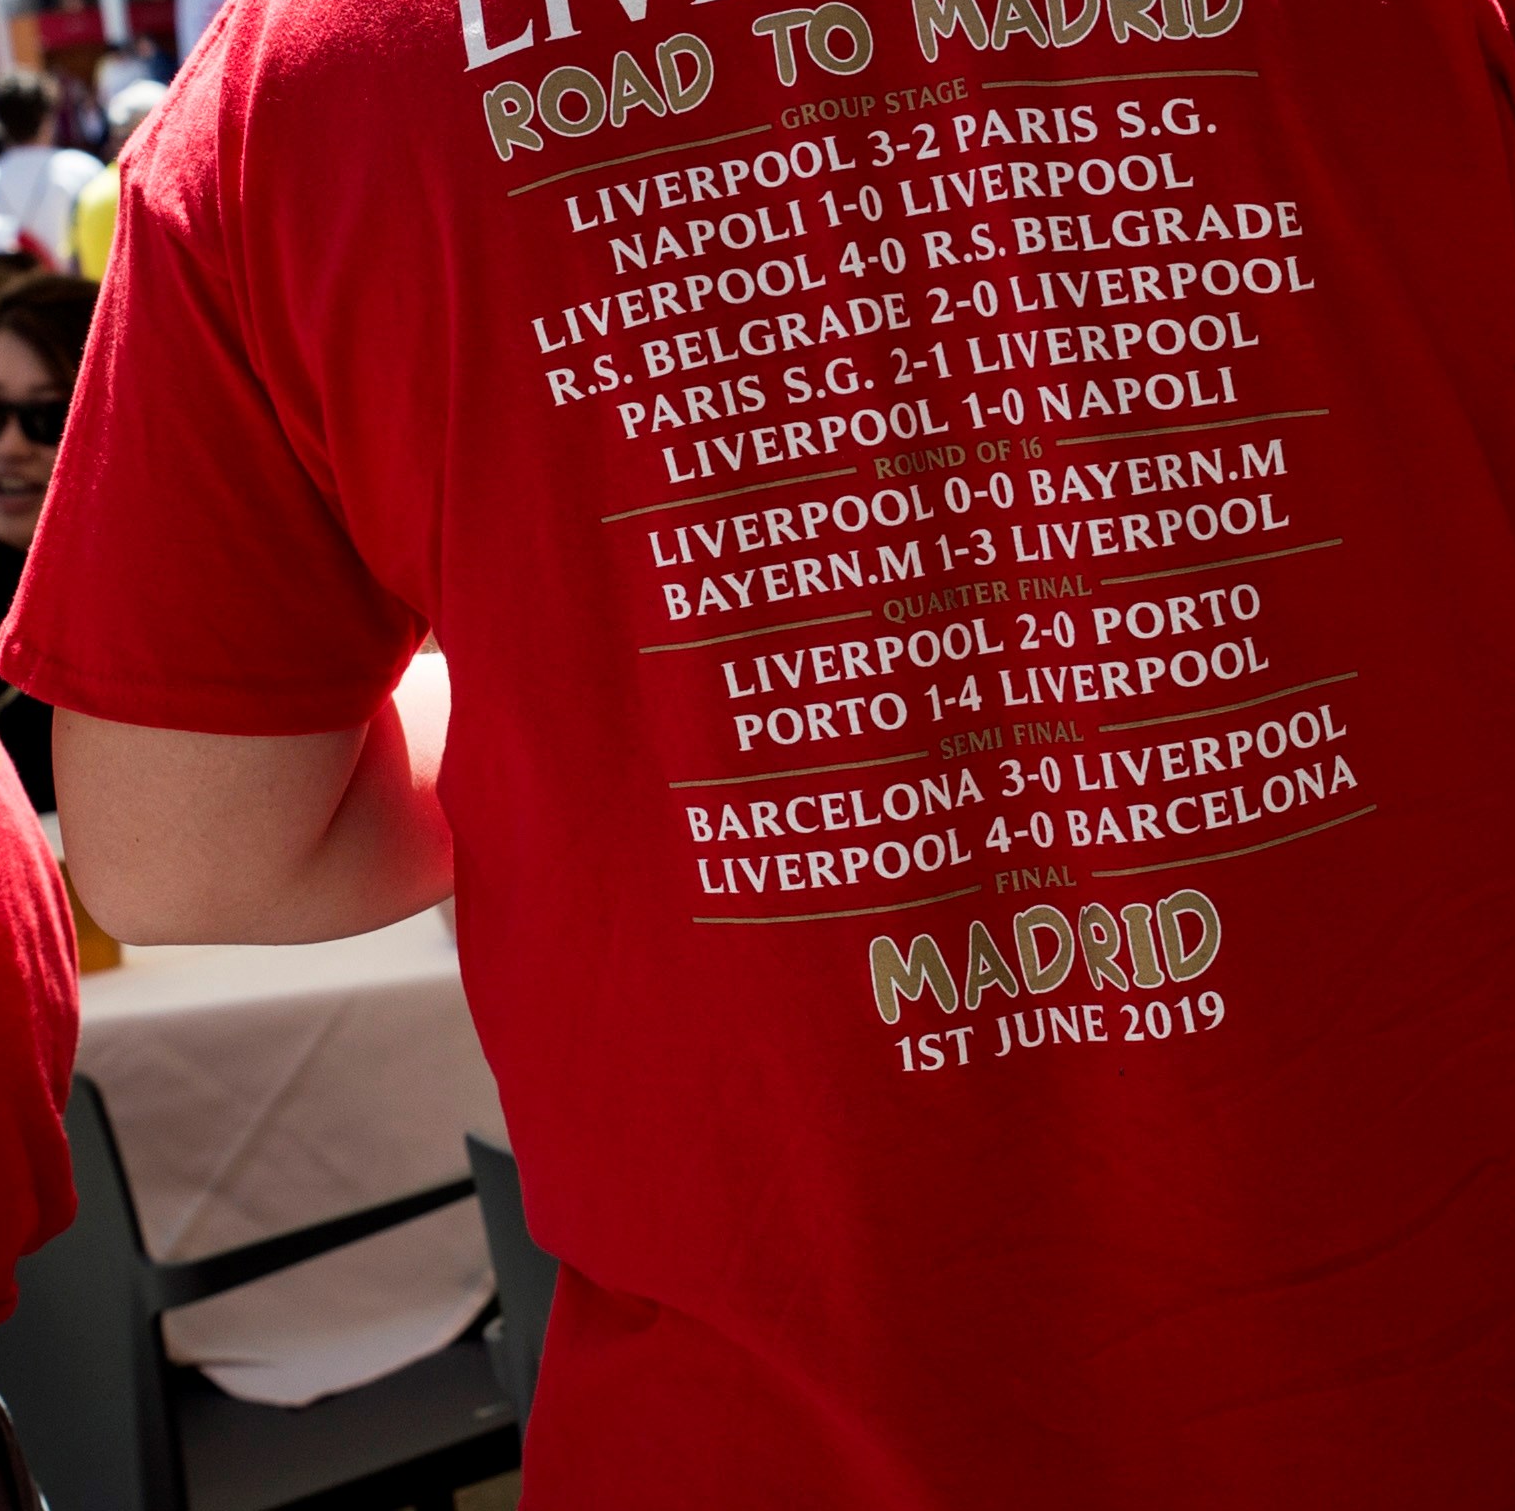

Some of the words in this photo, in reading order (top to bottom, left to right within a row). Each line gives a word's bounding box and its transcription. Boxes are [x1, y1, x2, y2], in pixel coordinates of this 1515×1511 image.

[482, 32, 715, 163] ROAD
[751, 1, 874, 88] TO
[780, 96, 880, 130] GROUP
[884, 77, 969, 114] STAGE
[565, 135, 856, 233] LIVERPOOL
[867, 123, 940, 167] 3-2
[952, 105, 1098, 153] PARIS
[1116, 97, 1217, 139] S.G.
[608, 199, 808, 275] NAPOLI
[818, 185, 883, 228] 1-0
[898, 152, 1194, 217] LIVERPOOL
[531, 253, 827, 354] LIVERPOOL
[838, 237, 906, 278] 4-0
[922, 223, 1006, 269] R.S.
[1011, 201, 1303, 255] BELGRADE
[545, 354, 633, 407] R.S.
[640, 292, 911, 379] BELGRADE
[926, 280, 999, 324] 2-0
[1009, 255, 1315, 313] LIVERPOOL
[616, 374, 766, 440] PARIS
[783, 357, 874, 404] S.G.
[890, 341, 952, 385] 2-1
[966, 311, 1259, 374] LIVERPOOL
[661, 398, 949, 484] LIVERPOOL
[961, 388, 1025, 429] 1-0
[1037, 366, 1238, 423] NAPOLI
[647, 484, 934, 568] LIVERPOOL
[944, 472, 1015, 514] 0-0
[1028, 438, 1288, 506] BAYERN.M
[873, 445, 966, 480] ROUND
[976, 439, 1011, 464] OF
[661, 540, 926, 621] BAYERN.M
[935, 528, 997, 571] 1-3
[1010, 493, 1290, 563] LIVERPOOL
[883, 580, 1010, 624] QUARTER
[1018, 574, 1093, 601] FINAL
[721, 618, 1004, 699] LIVERPOOL
[1015, 610, 1075, 650] 2-0
[1091, 584, 1260, 645] PORTO
[733, 692, 908, 752] PORTO
[924, 674, 983, 722] 1-4
[998, 636, 1269, 706] LIVERPOOL
[685, 768, 985, 843] BARCELONA
[999, 756, 1061, 797] 3-0
[1073, 704, 1347, 791] LIVERPOOL
[941, 727, 1003, 760] SEMI
[1013, 720, 1084, 745] FINAL
[697, 828, 972, 894] LIVERPOOL
[985, 811, 1054, 853] 4-0
[1065, 754, 1358, 847] BARCELONA
[995, 866, 1077, 894] FINAL
[868, 888, 1222, 1026] MADRID
[895, 1026, 974, 1072] 1ST
[995, 1004, 1108, 1057] JUNE
[1119, 990, 1225, 1042] 2019
